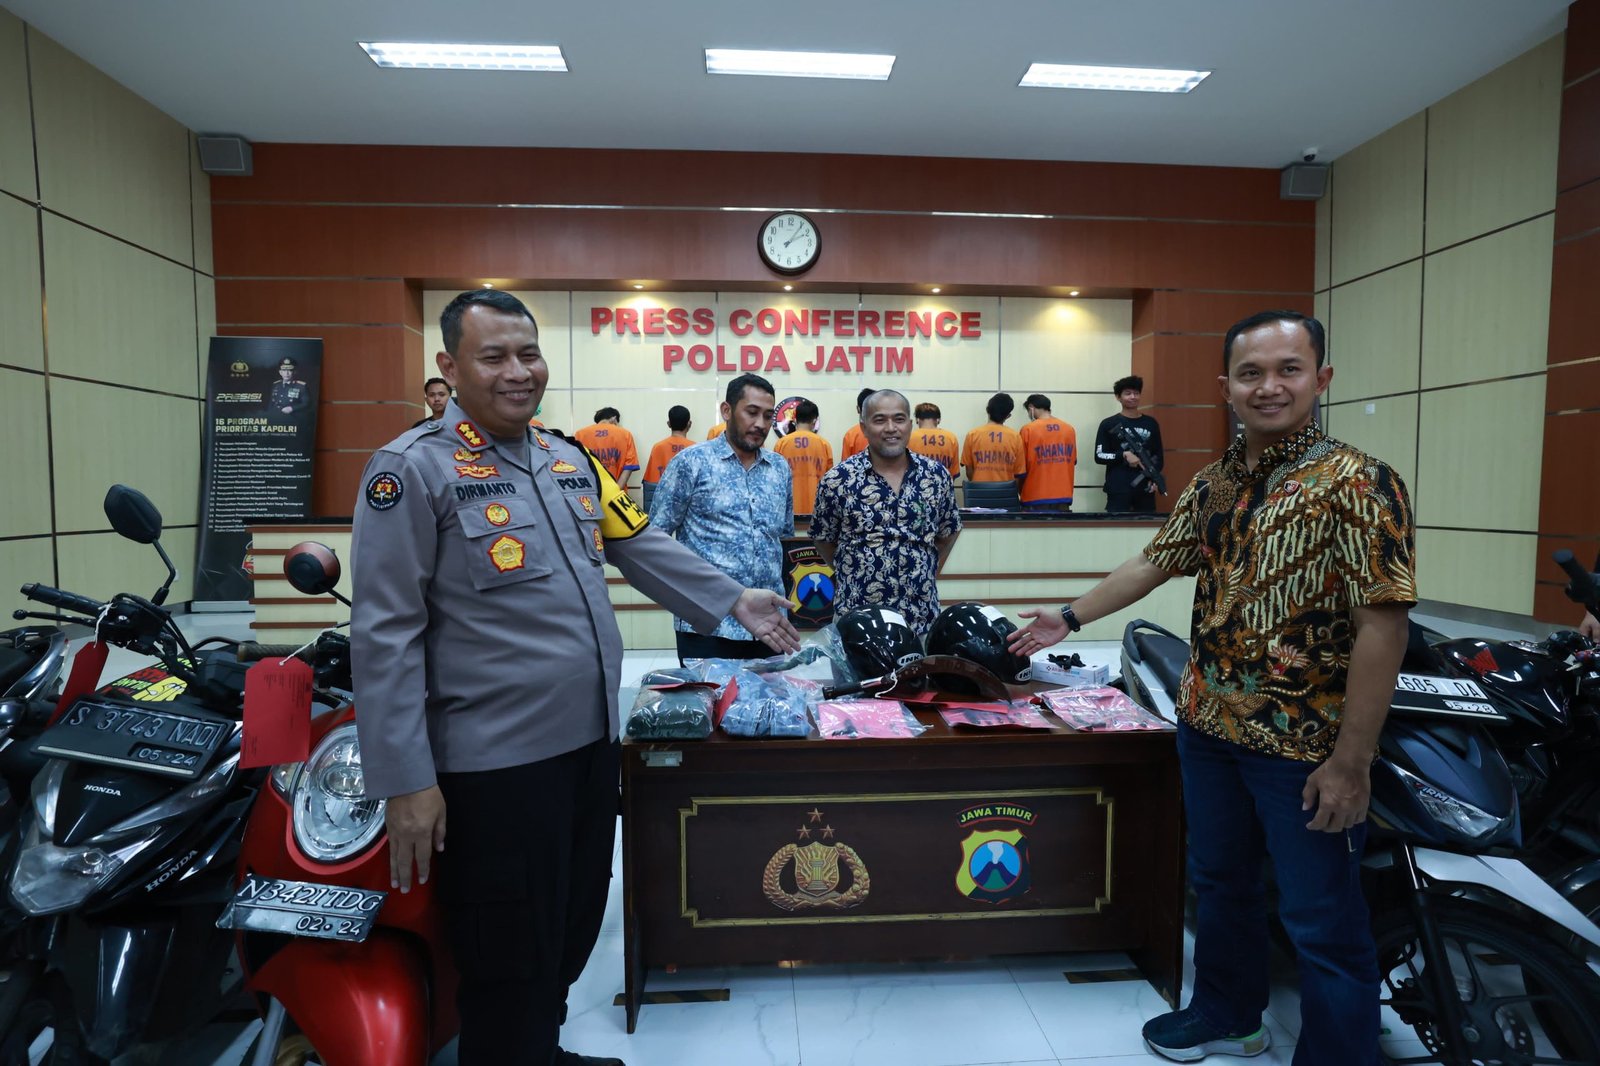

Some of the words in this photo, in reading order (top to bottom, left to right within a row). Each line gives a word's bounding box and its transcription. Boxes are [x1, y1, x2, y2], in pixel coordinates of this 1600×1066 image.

[591, 307, 715, 336] PRESS
[729, 308, 982, 338] CONFERENCE
[662, 344, 790, 373] POLDA
[805, 345, 914, 373] JATIM
[794, 437, 809, 448] 50
[922, 435, 945, 446] 143
[989, 432, 1002, 443] 11
[557, 477, 592, 490] POLRI
[455, 482, 517, 501] DIRMANTO
[796, 550, 814, 558] JAWA
[900, 655, 920, 664] INK
[70, 707, 91, 725] S
[97, 710, 164, 738] 3743
[84, 784, 121, 796] HONDA
[961, 807, 992, 823] JAWA
[995, 806, 1032, 821] TIMUR
[145, 849, 198, 892] HONDA
